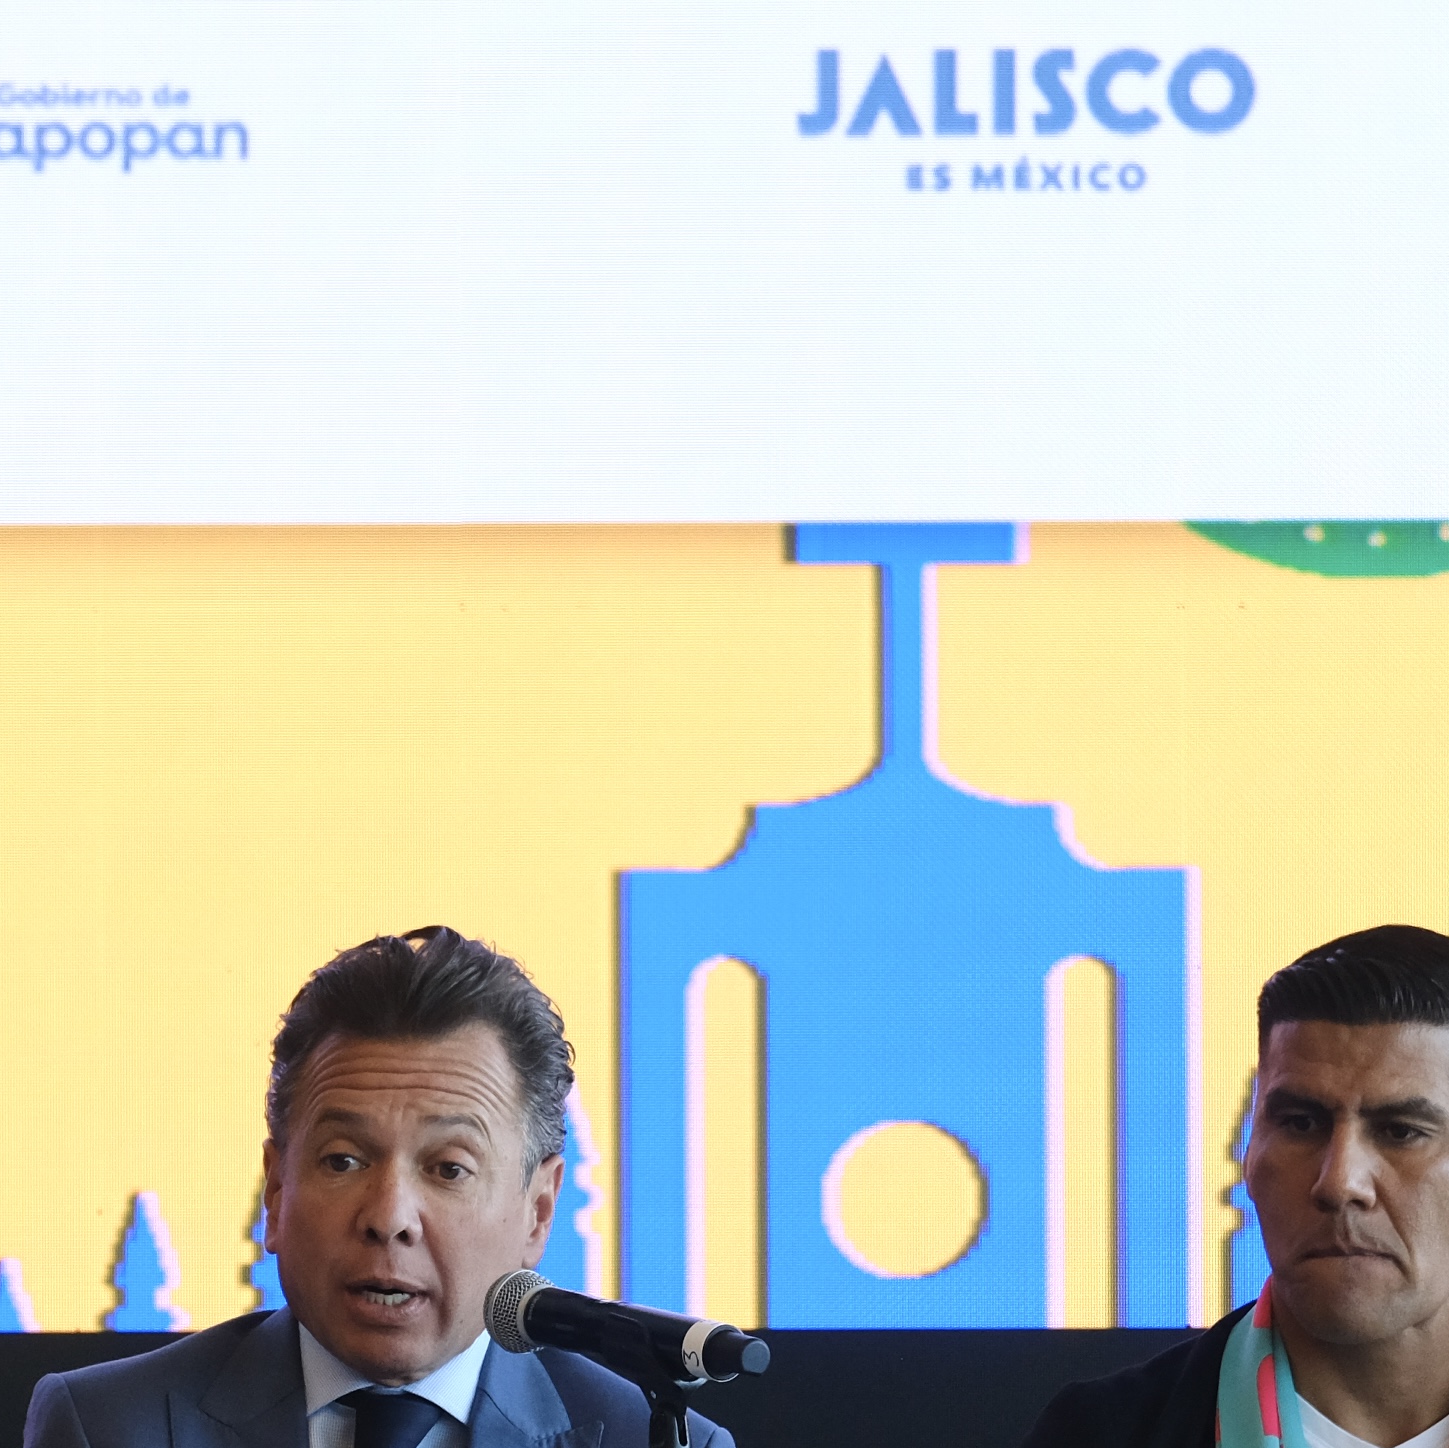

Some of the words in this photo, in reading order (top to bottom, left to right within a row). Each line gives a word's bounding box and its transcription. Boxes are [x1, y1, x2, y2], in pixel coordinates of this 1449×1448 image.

[153, 84, 191, 107] de
[797, 47, 1256, 137] JALISCO
[905, 163, 952, 192] ES
[970, 157, 1148, 192] MÉXICO
